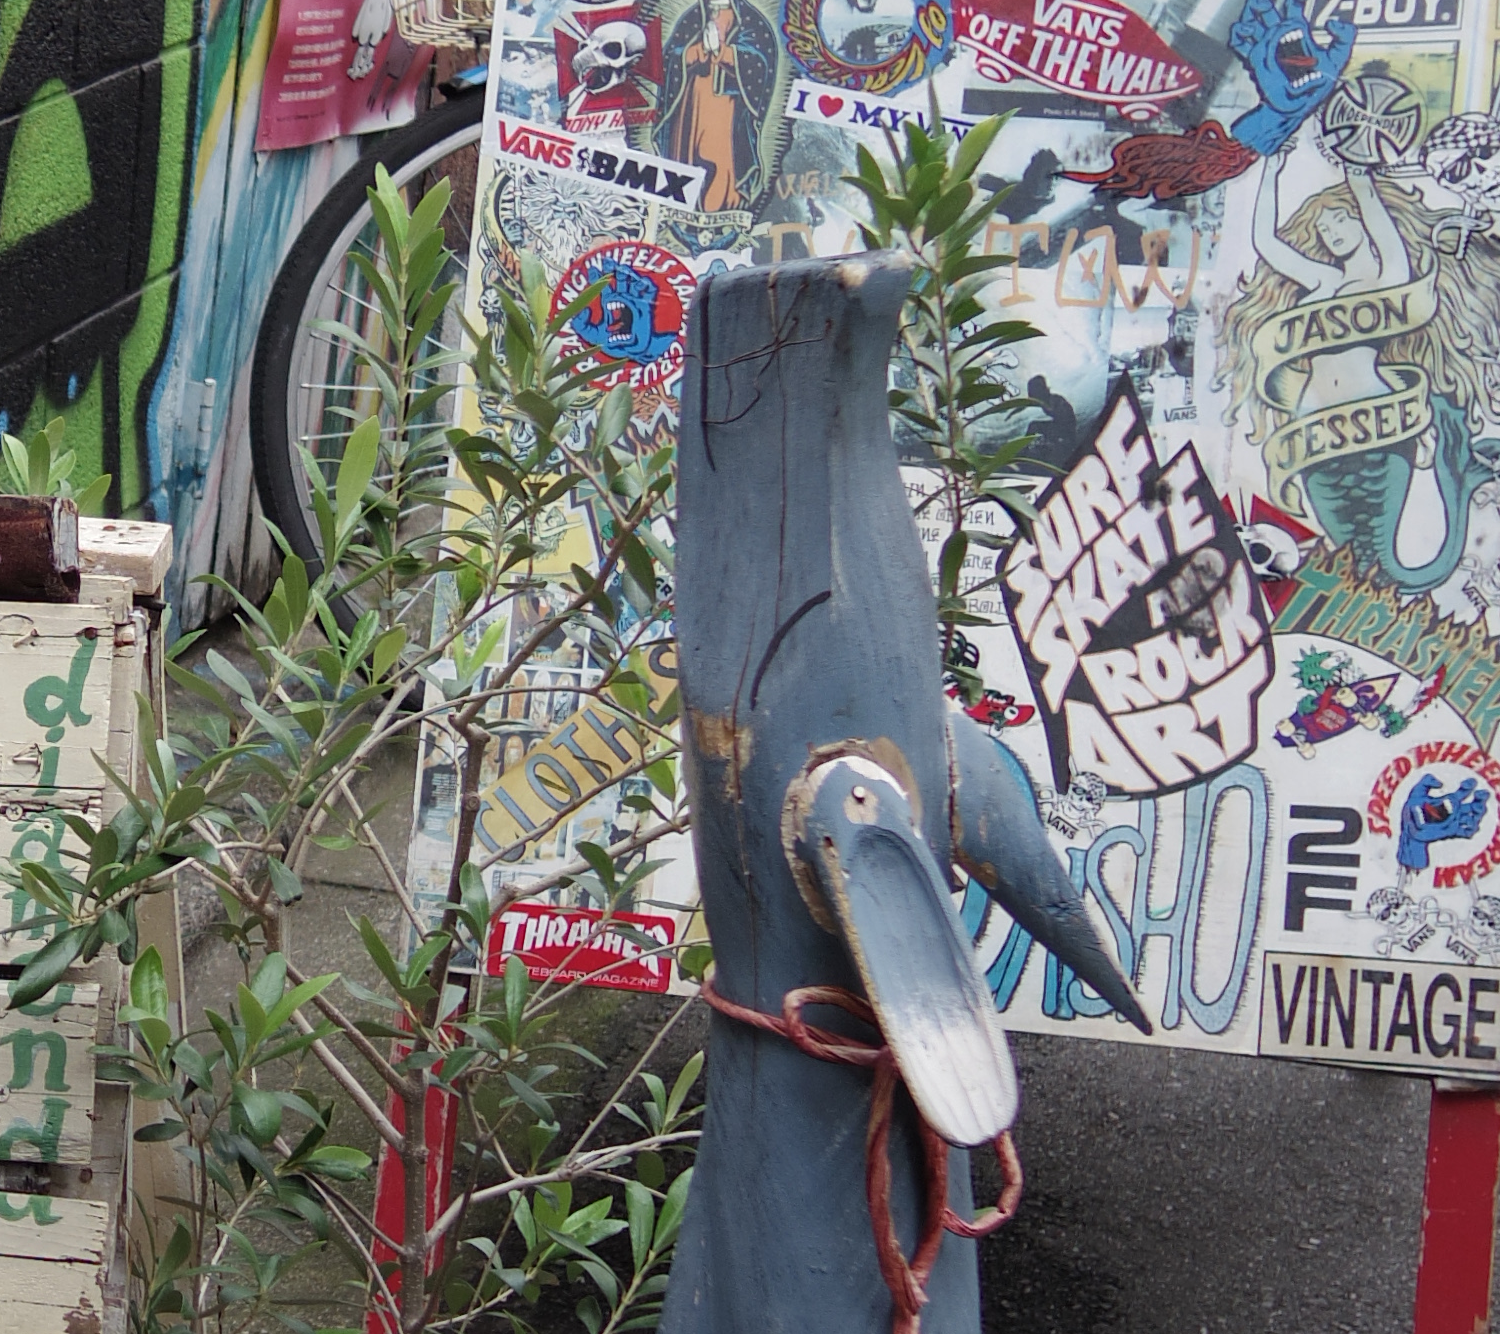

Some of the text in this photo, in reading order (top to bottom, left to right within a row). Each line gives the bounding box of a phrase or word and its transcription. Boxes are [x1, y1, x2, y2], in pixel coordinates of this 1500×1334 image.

[1027, 28, 1098, 90] THE
[793, 89, 811, 113] I
[849, 100, 911, 133] MY
[496, 118, 696, 205] VANS BMX
[1312, 133, 1342, 169] TRUCK
[1273, 293, 1411, 355] JASON
[1163, 405, 1198, 423] VANS
[1279, 398, 1421, 466] JESSEE
[1006, 395, 1152, 643] SURF
[1029, 448, 1216, 714] SKATE
[1079, 560, 1263, 715] ROCK
[1270, 557, 1500, 751] THRASHER
[1065, 644, 1269, 793] ART
[1043, 810, 1077, 841] VANS
[1366, 755, 1413, 839] SPEED
[499, 910, 670, 969] THRASHER
[1400, 923, 1437, 955] VANS
[1444, 935, 1480, 966] VANS
[587, 969, 660, 989] MAGAZINE
[1271, 963, 1499, 1061] VINTAGE
